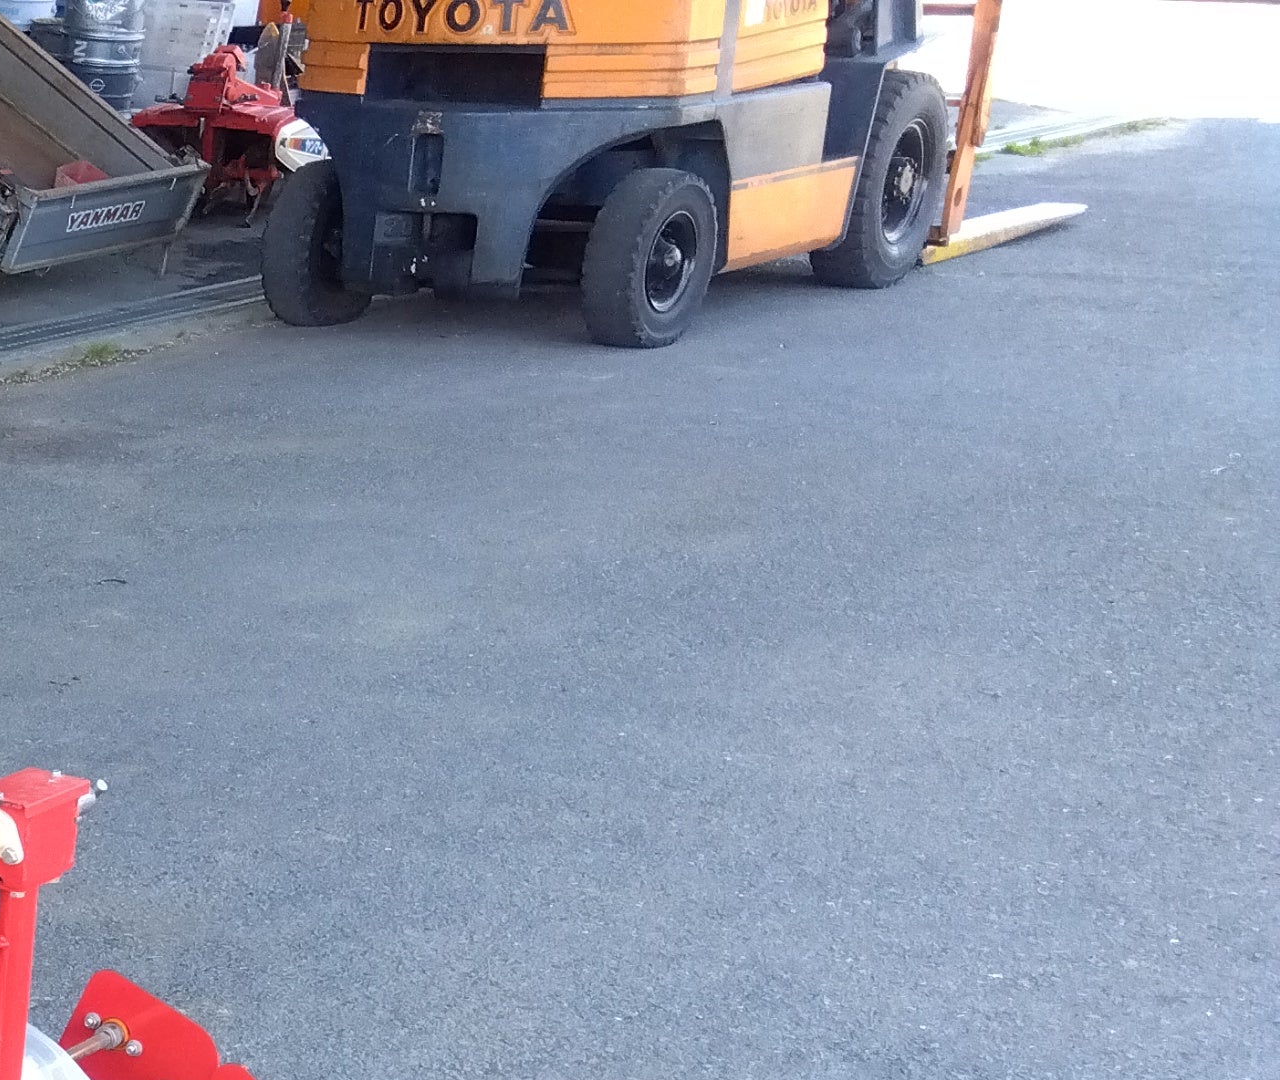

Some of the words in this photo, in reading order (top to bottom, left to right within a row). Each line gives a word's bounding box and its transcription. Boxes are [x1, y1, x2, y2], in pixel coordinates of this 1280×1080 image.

[356, 0, 575, 34] TOYOTA
[305, 139, 323, 153] ヤンマ
[66, 201, 145, 232] YANMAR
